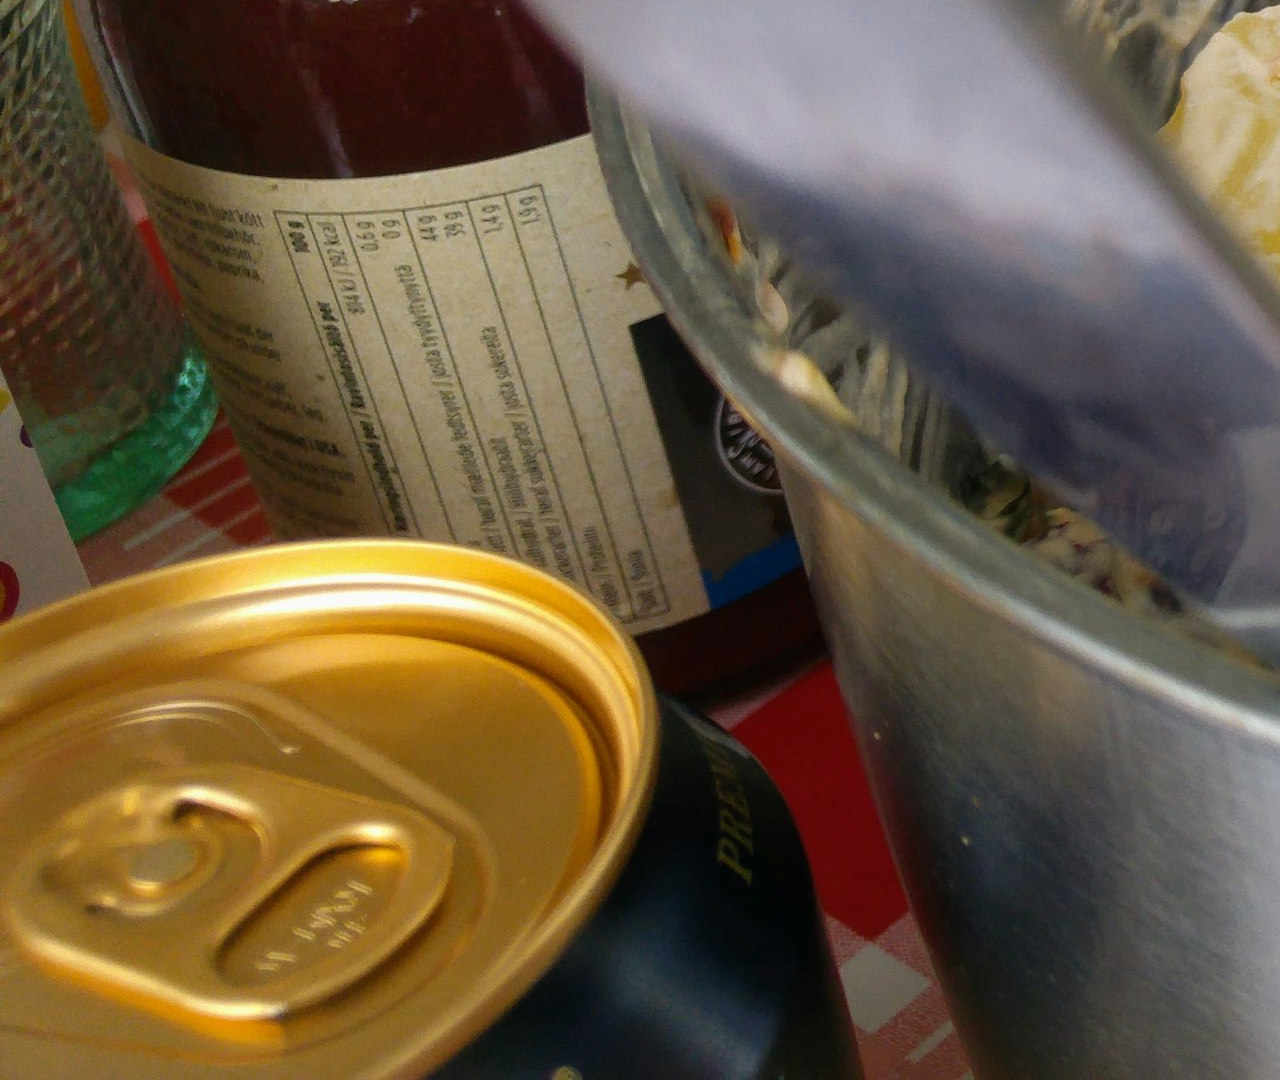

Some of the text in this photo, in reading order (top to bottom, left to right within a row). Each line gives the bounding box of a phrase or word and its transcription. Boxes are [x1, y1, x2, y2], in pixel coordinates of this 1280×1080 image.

[518, 195, 538, 204] g
[443, 211, 463, 220] g
[481, 204, 501, 213] g
[288, 219, 303, 229] g
[381, 219, 400, 227] g
[418, 215, 437, 224] g
[518, 208, 543, 225] 1,9
[443, 223, 466, 238] 39
[481, 216, 506, 233] 1,4
[317, 220, 341, 245] kcal
[356, 220, 380, 251] 0,6 g
[381, 231, 401, 239] 0
[418, 227, 440, 242] 44
[288, 231, 310, 252] 100
[317, 300, 338, 321] per
